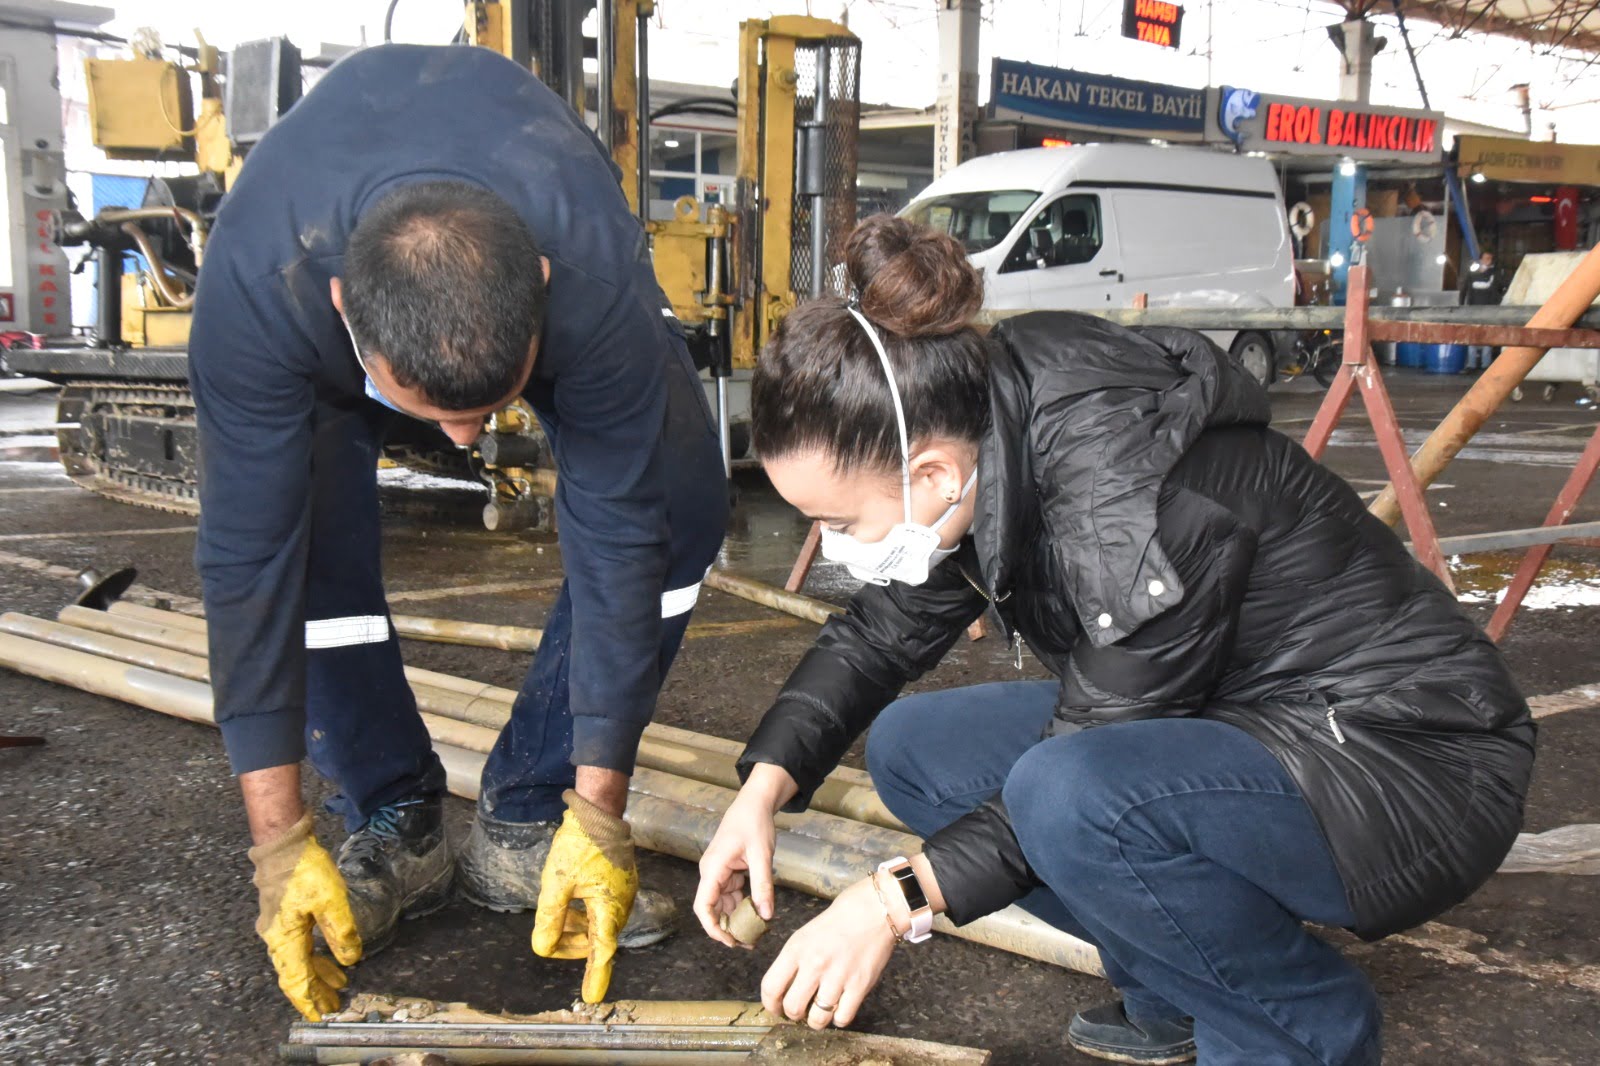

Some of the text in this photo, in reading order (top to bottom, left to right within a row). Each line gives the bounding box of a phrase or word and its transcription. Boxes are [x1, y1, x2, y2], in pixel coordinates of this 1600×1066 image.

[1136, 21, 1171, 47] TAVA
[1002, 72, 1080, 103] HAKAN
[1086, 84, 1147, 113] TEKEL
[1266, 102, 1322, 145] EROL
